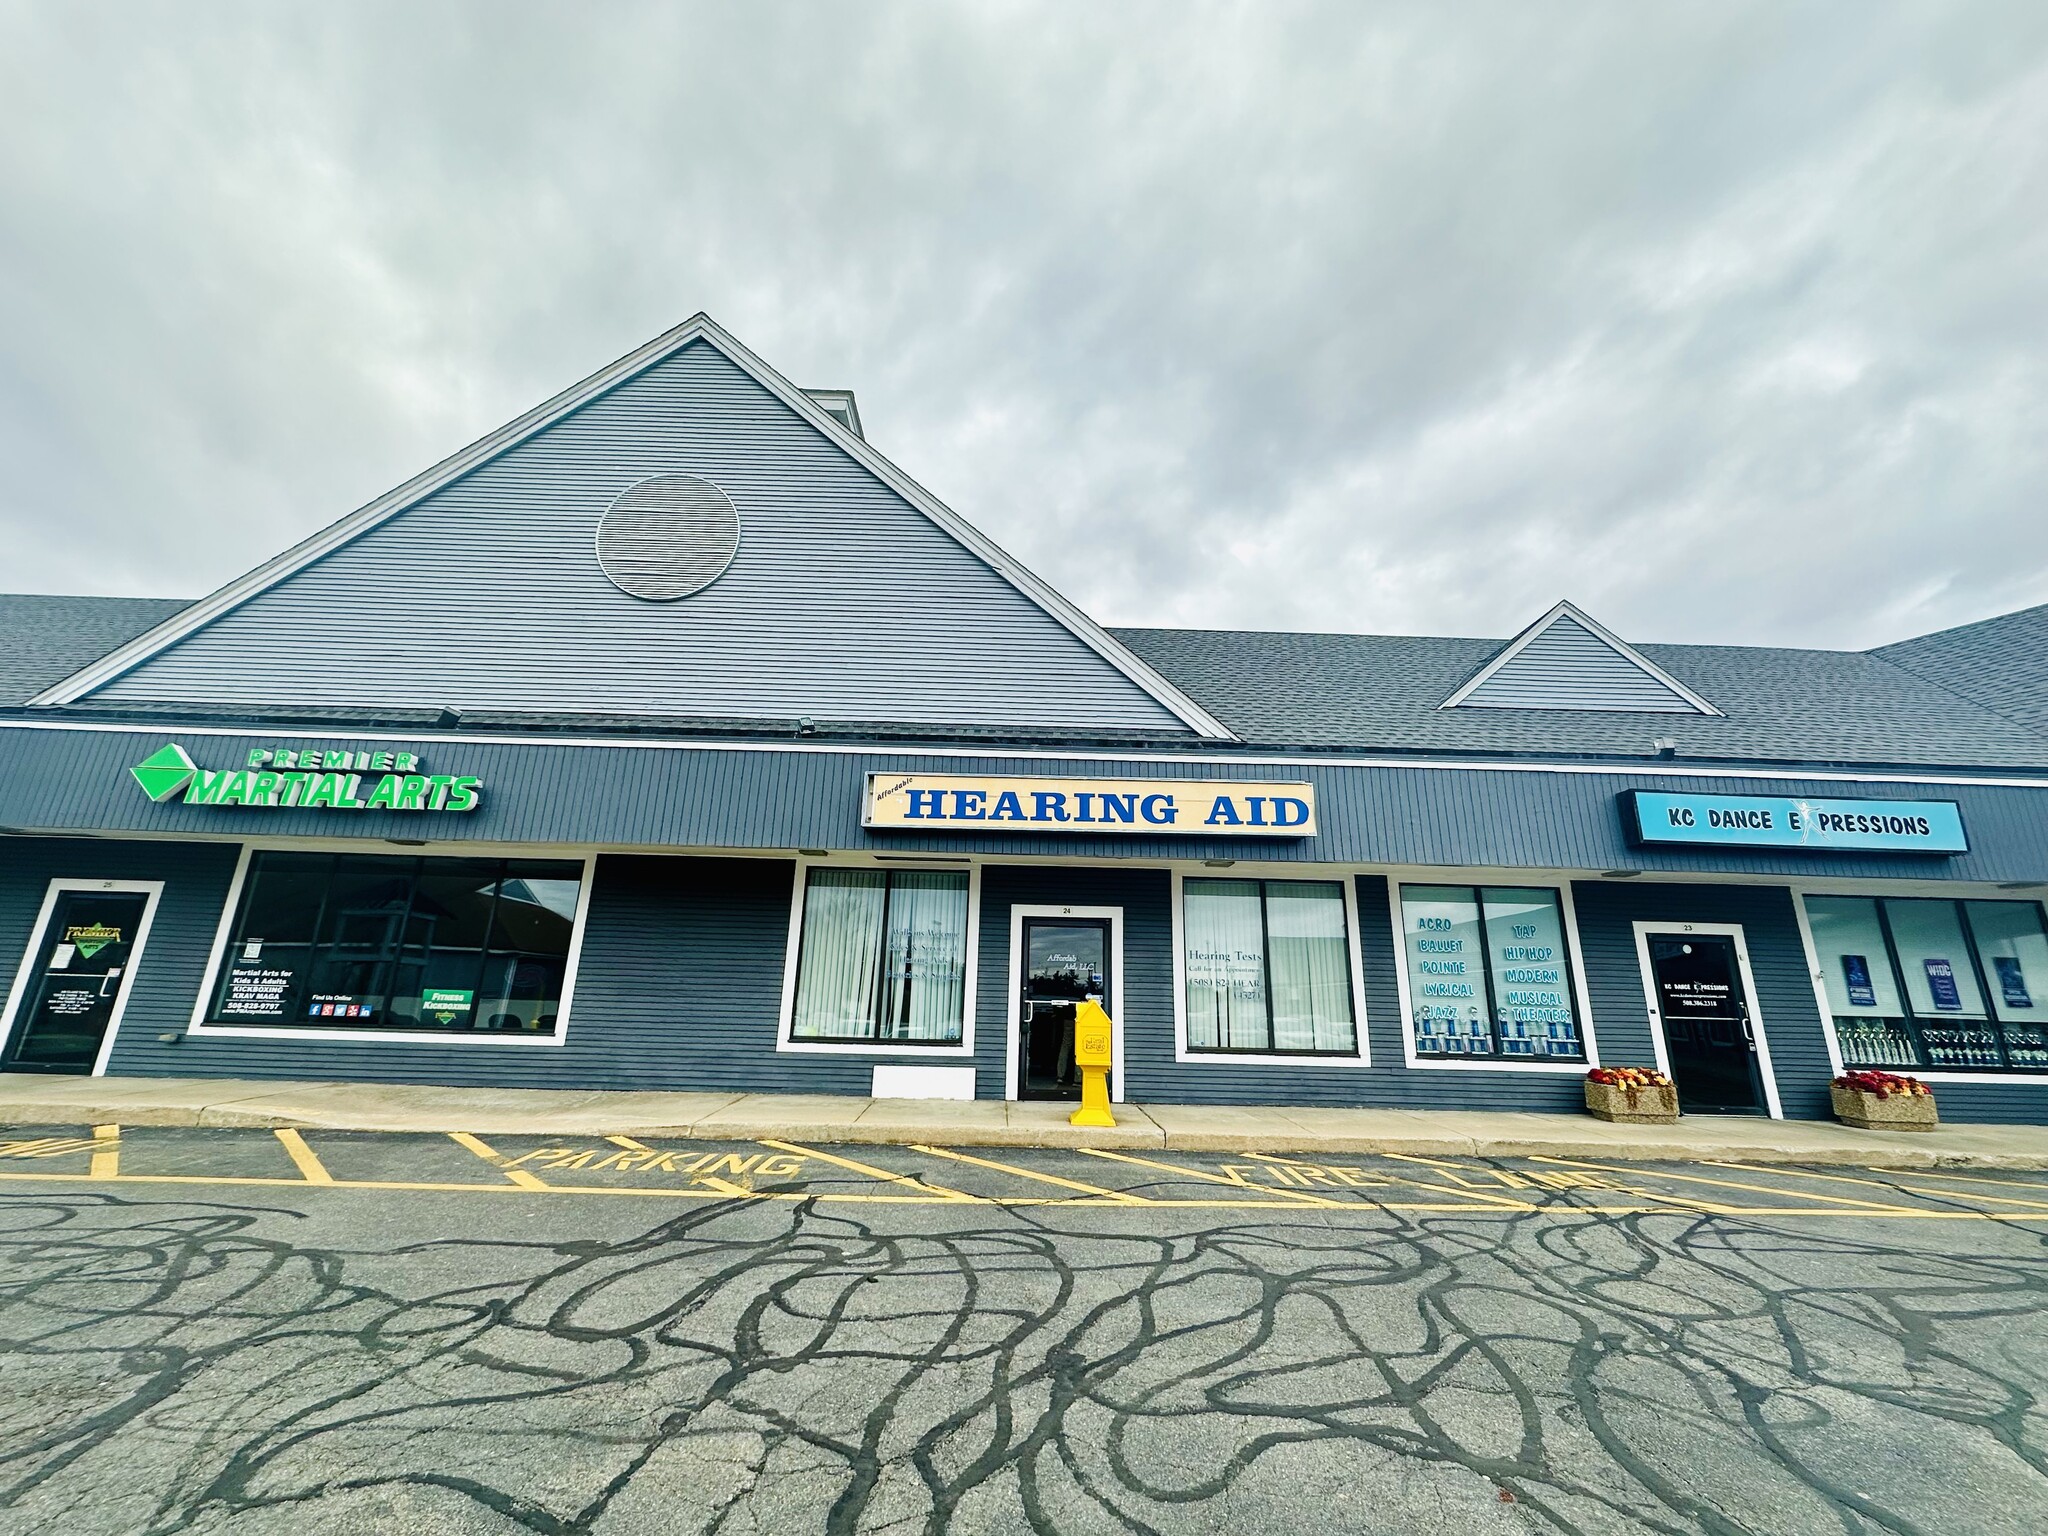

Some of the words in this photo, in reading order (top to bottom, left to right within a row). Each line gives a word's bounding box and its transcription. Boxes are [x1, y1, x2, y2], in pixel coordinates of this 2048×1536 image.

[248, 749, 417, 771] PREMIER
[184, 770, 363, 808] MARTIAL
[366, 775, 483, 812] ARTS
[877, 777, 913, 801] Affordable
[904, 789, 1179, 824] HEARING
[1204, 796, 1310, 827] AID
[1668, 808, 1696, 827] KC
[1708, 810, 1773, 829] DANCE
[1062, 907, 1072, 915] 24
[1418, 917, 1452, 931] ACRO
[1513, 924, 1537, 938] TAP
[1419, 939, 1464, 952] BALLET
[1189, 950, 1231, 962] Hearing
[1234, 951, 1262, 961] Tests
[1505, 946, 1525, 960] HIP
[1528, 947, 1553, 961] HOP
[261, 969, 280, 977] Arts
[1422, 961, 1466, 974] POINTE
[1506, 969, 1560, 983] MODERN
[1424, 983, 1475, 997] LYRICAL
[1509, 991, 1564, 1005] MUSICAL
[1427, 1006, 1459, 1020] JAZZ
[1512, 1007, 1569, 1023] THEATER
[499, 1148, 806, 1175] PARKING
[1220, 1165, 1390, 1187] FIRE
